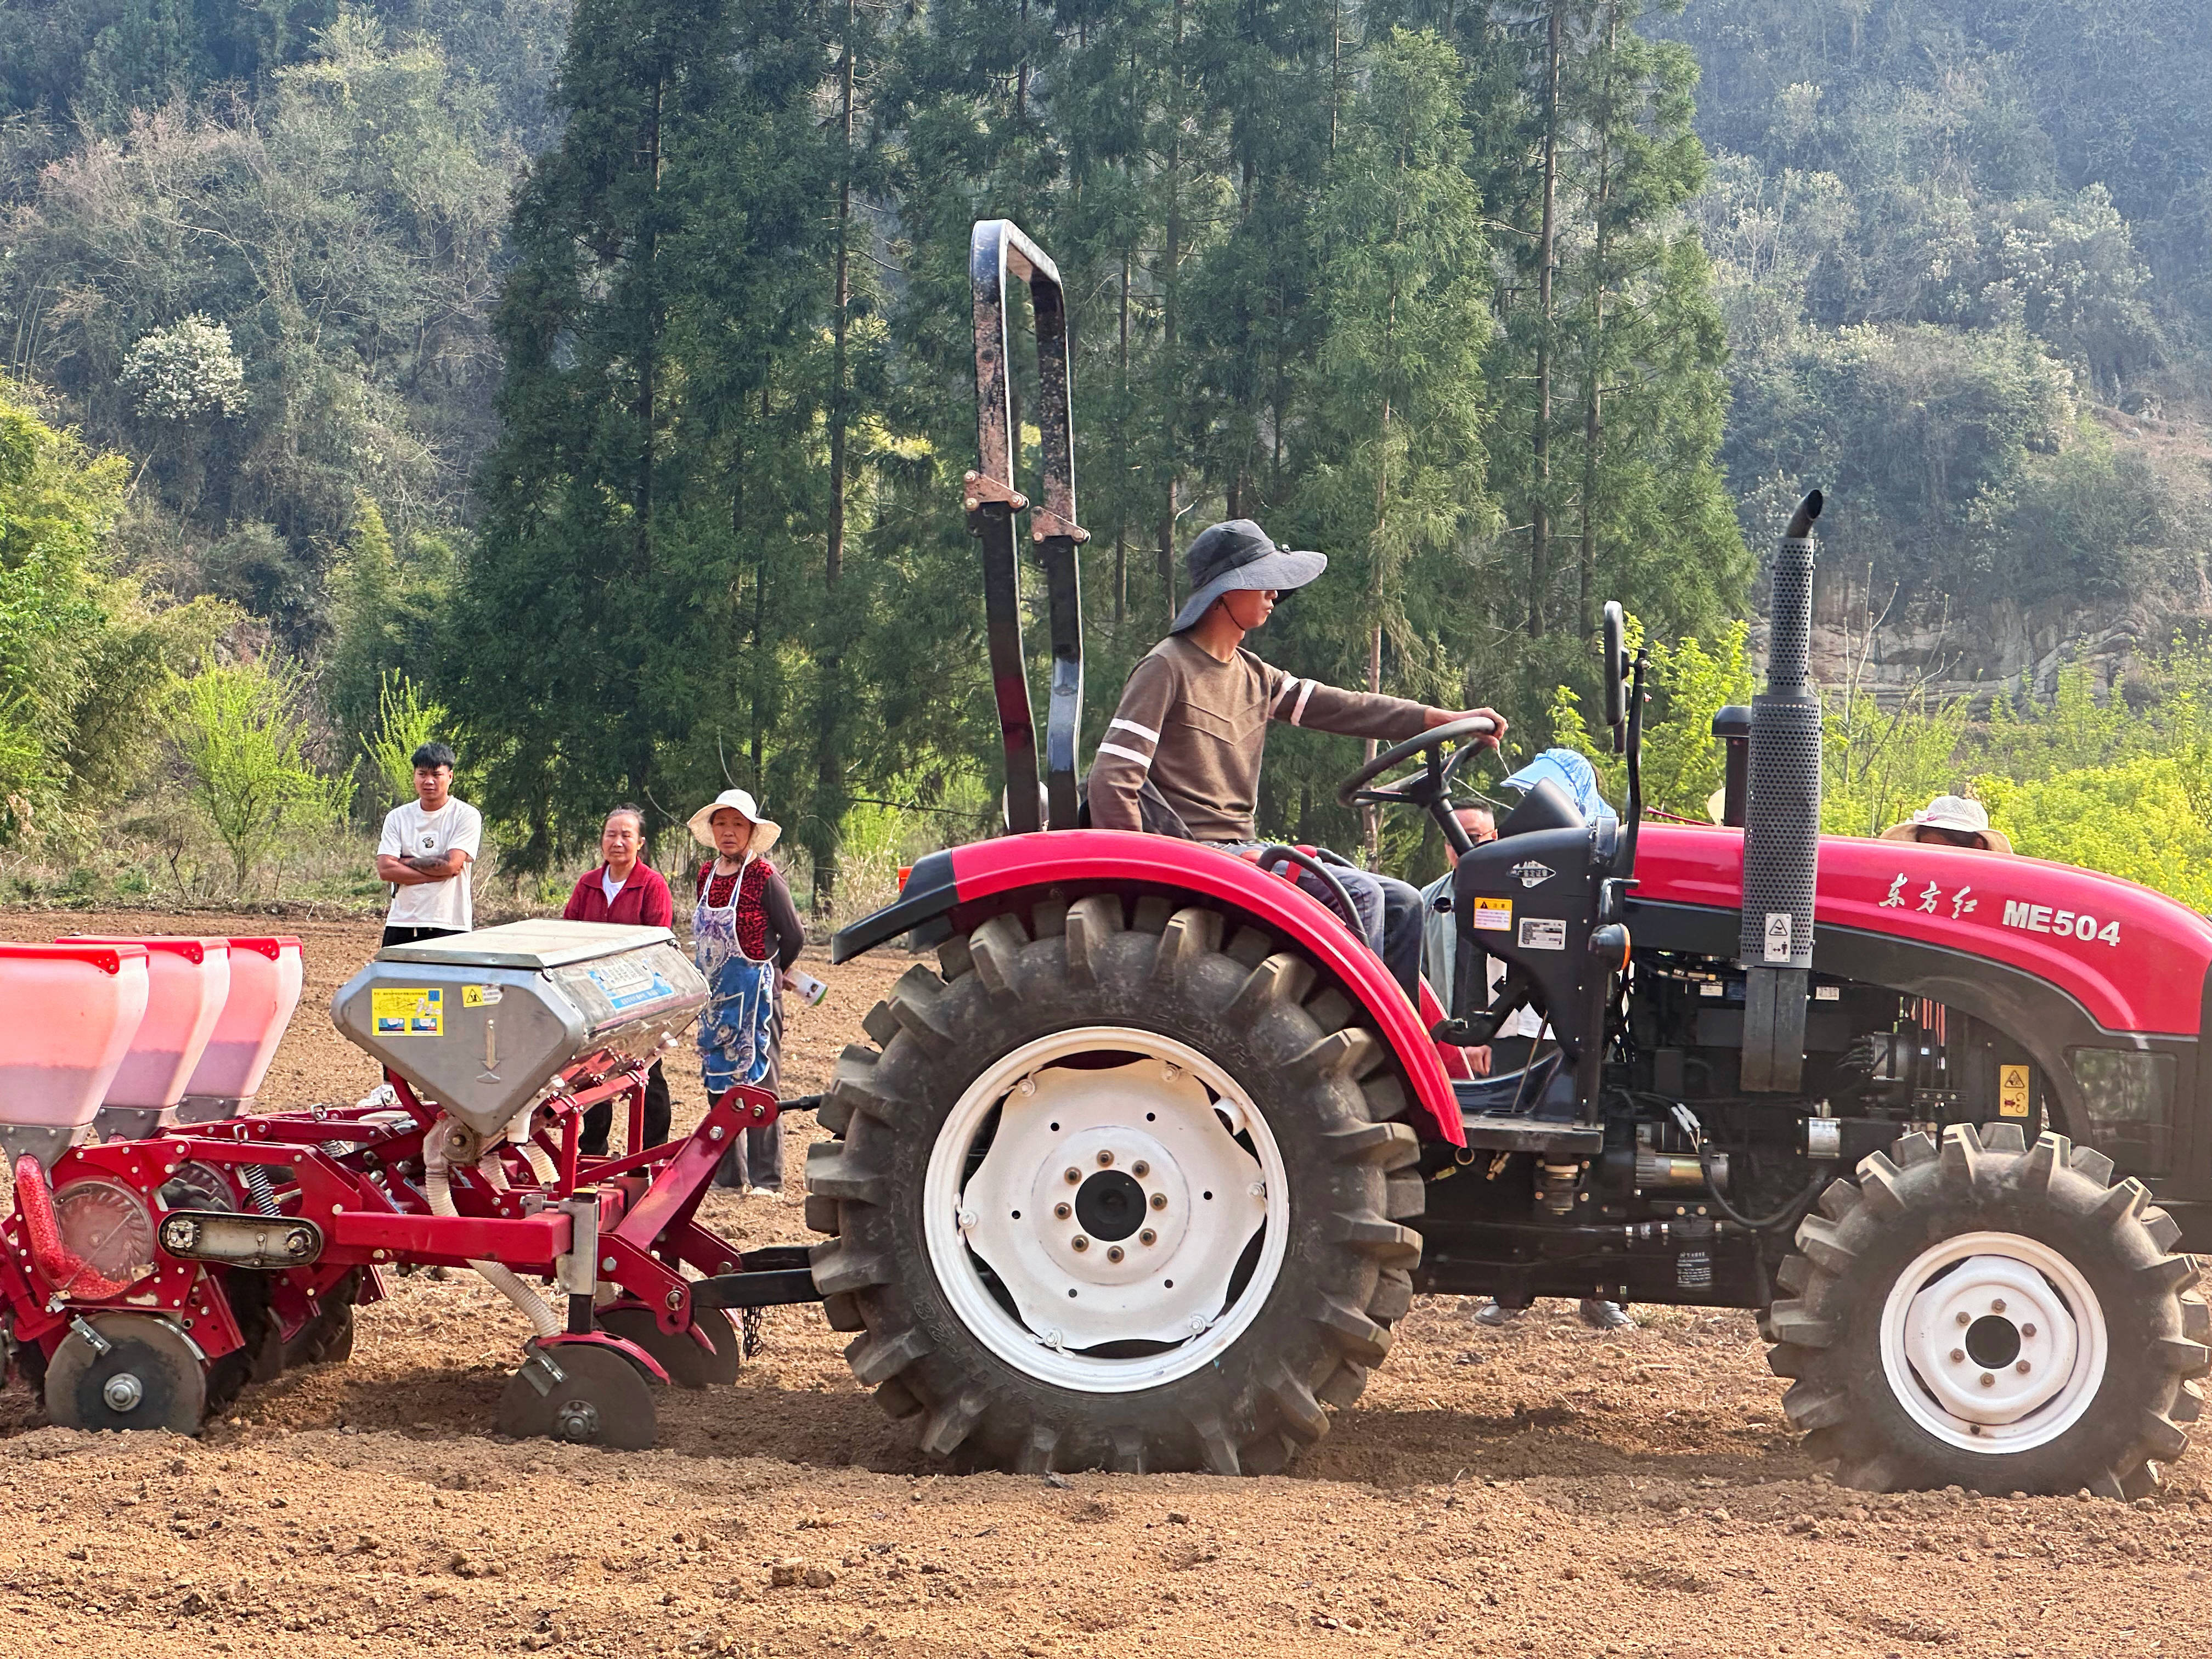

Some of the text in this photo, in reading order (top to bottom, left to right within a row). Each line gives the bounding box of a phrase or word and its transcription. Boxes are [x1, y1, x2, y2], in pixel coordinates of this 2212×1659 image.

[1879, 872, 2120, 947] 东方红 ME504
